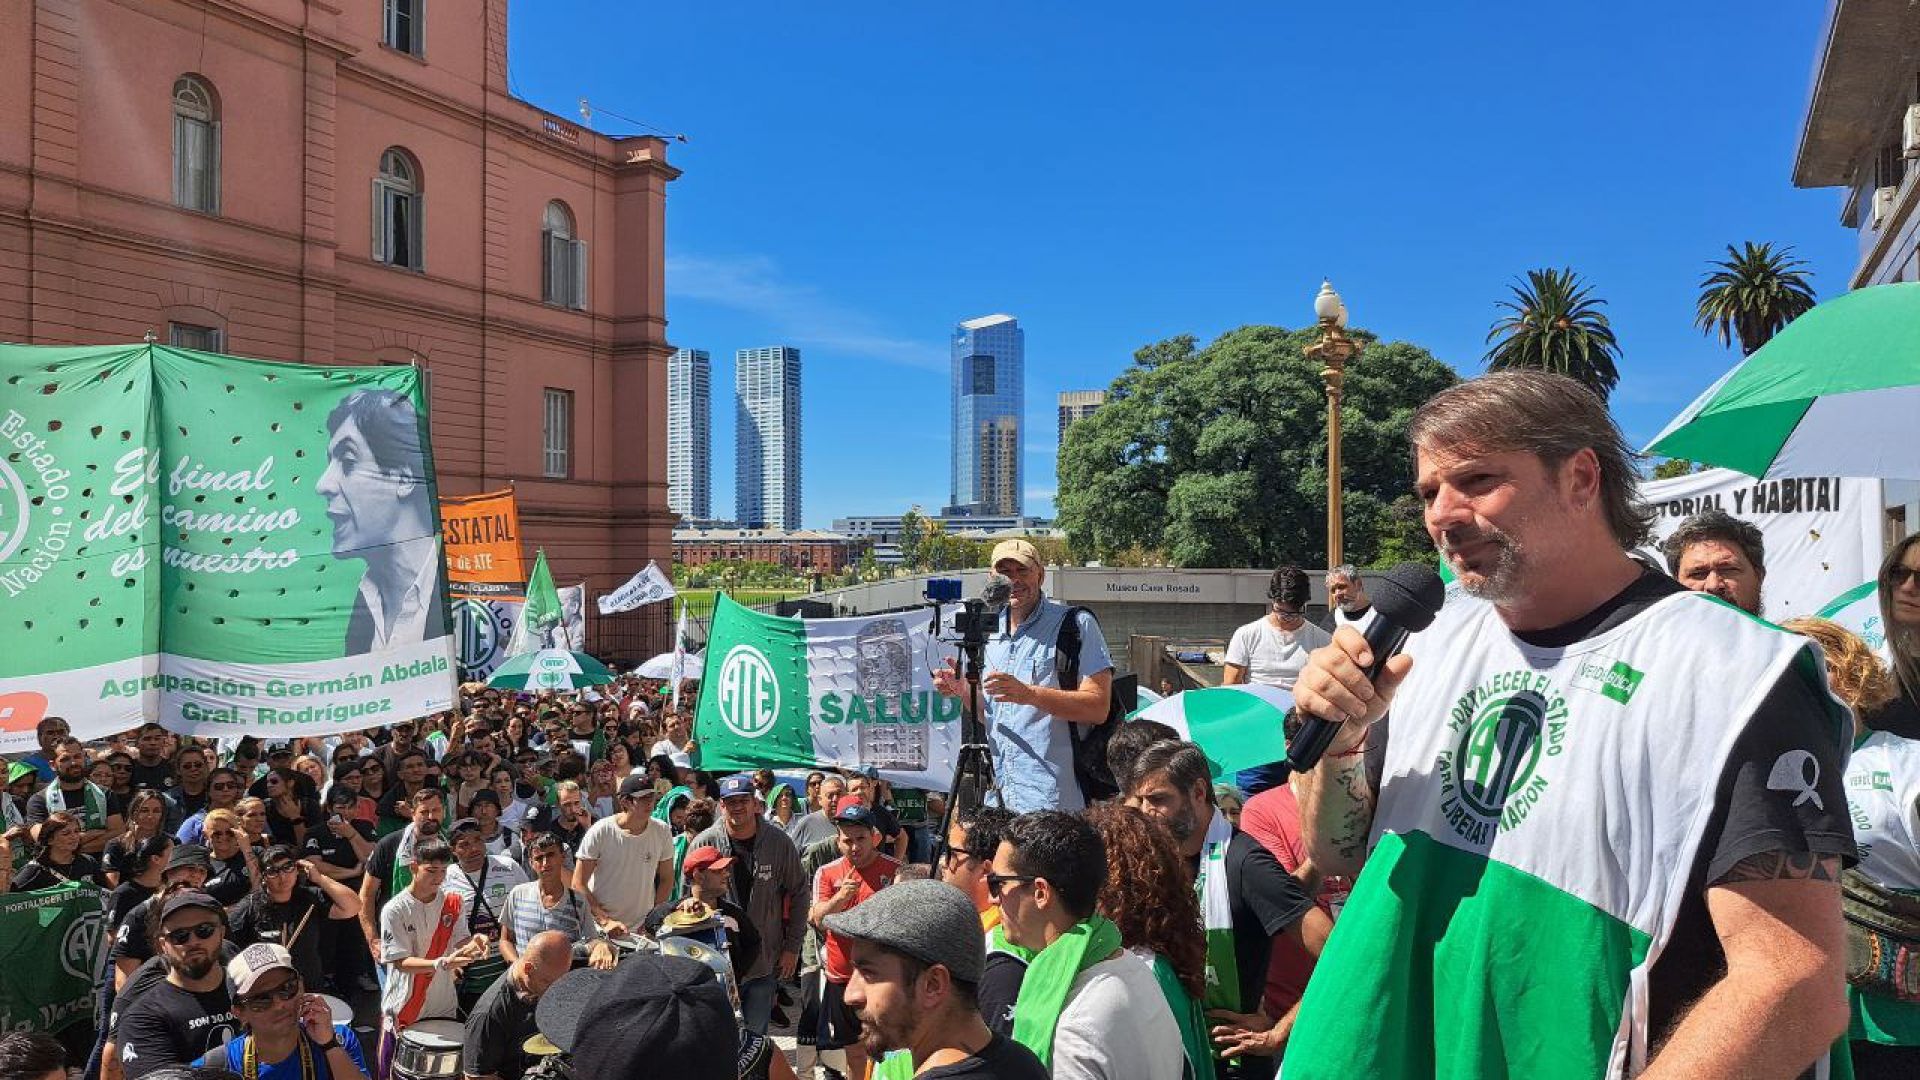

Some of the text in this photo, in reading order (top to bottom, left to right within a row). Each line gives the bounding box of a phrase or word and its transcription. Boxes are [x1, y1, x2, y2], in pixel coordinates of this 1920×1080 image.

[1, 409, 71, 500] Estado
[110, 446, 275, 496] El final
[83, 494, 301, 542] del camino
[1733, 488, 1748, 515] Y
[441, 513, 515, 545] ESTATAL
[0, 521, 73, 598] Nación
[110, 546, 301, 578] es nuestro
[474, 553, 493, 570] ATE
[1106, 583, 1201, 593] Museo Casa Rosada
[99, 655, 449, 700] Agrupación Germán Abdala
[722, 654, 773, 730] ATE
[181, 698, 392, 725] Gral. Rodríguez
[819, 691, 963, 725] SALUD
[1545, 690, 1570, 757] STADO
[188, 1016, 209, 1030] SON
